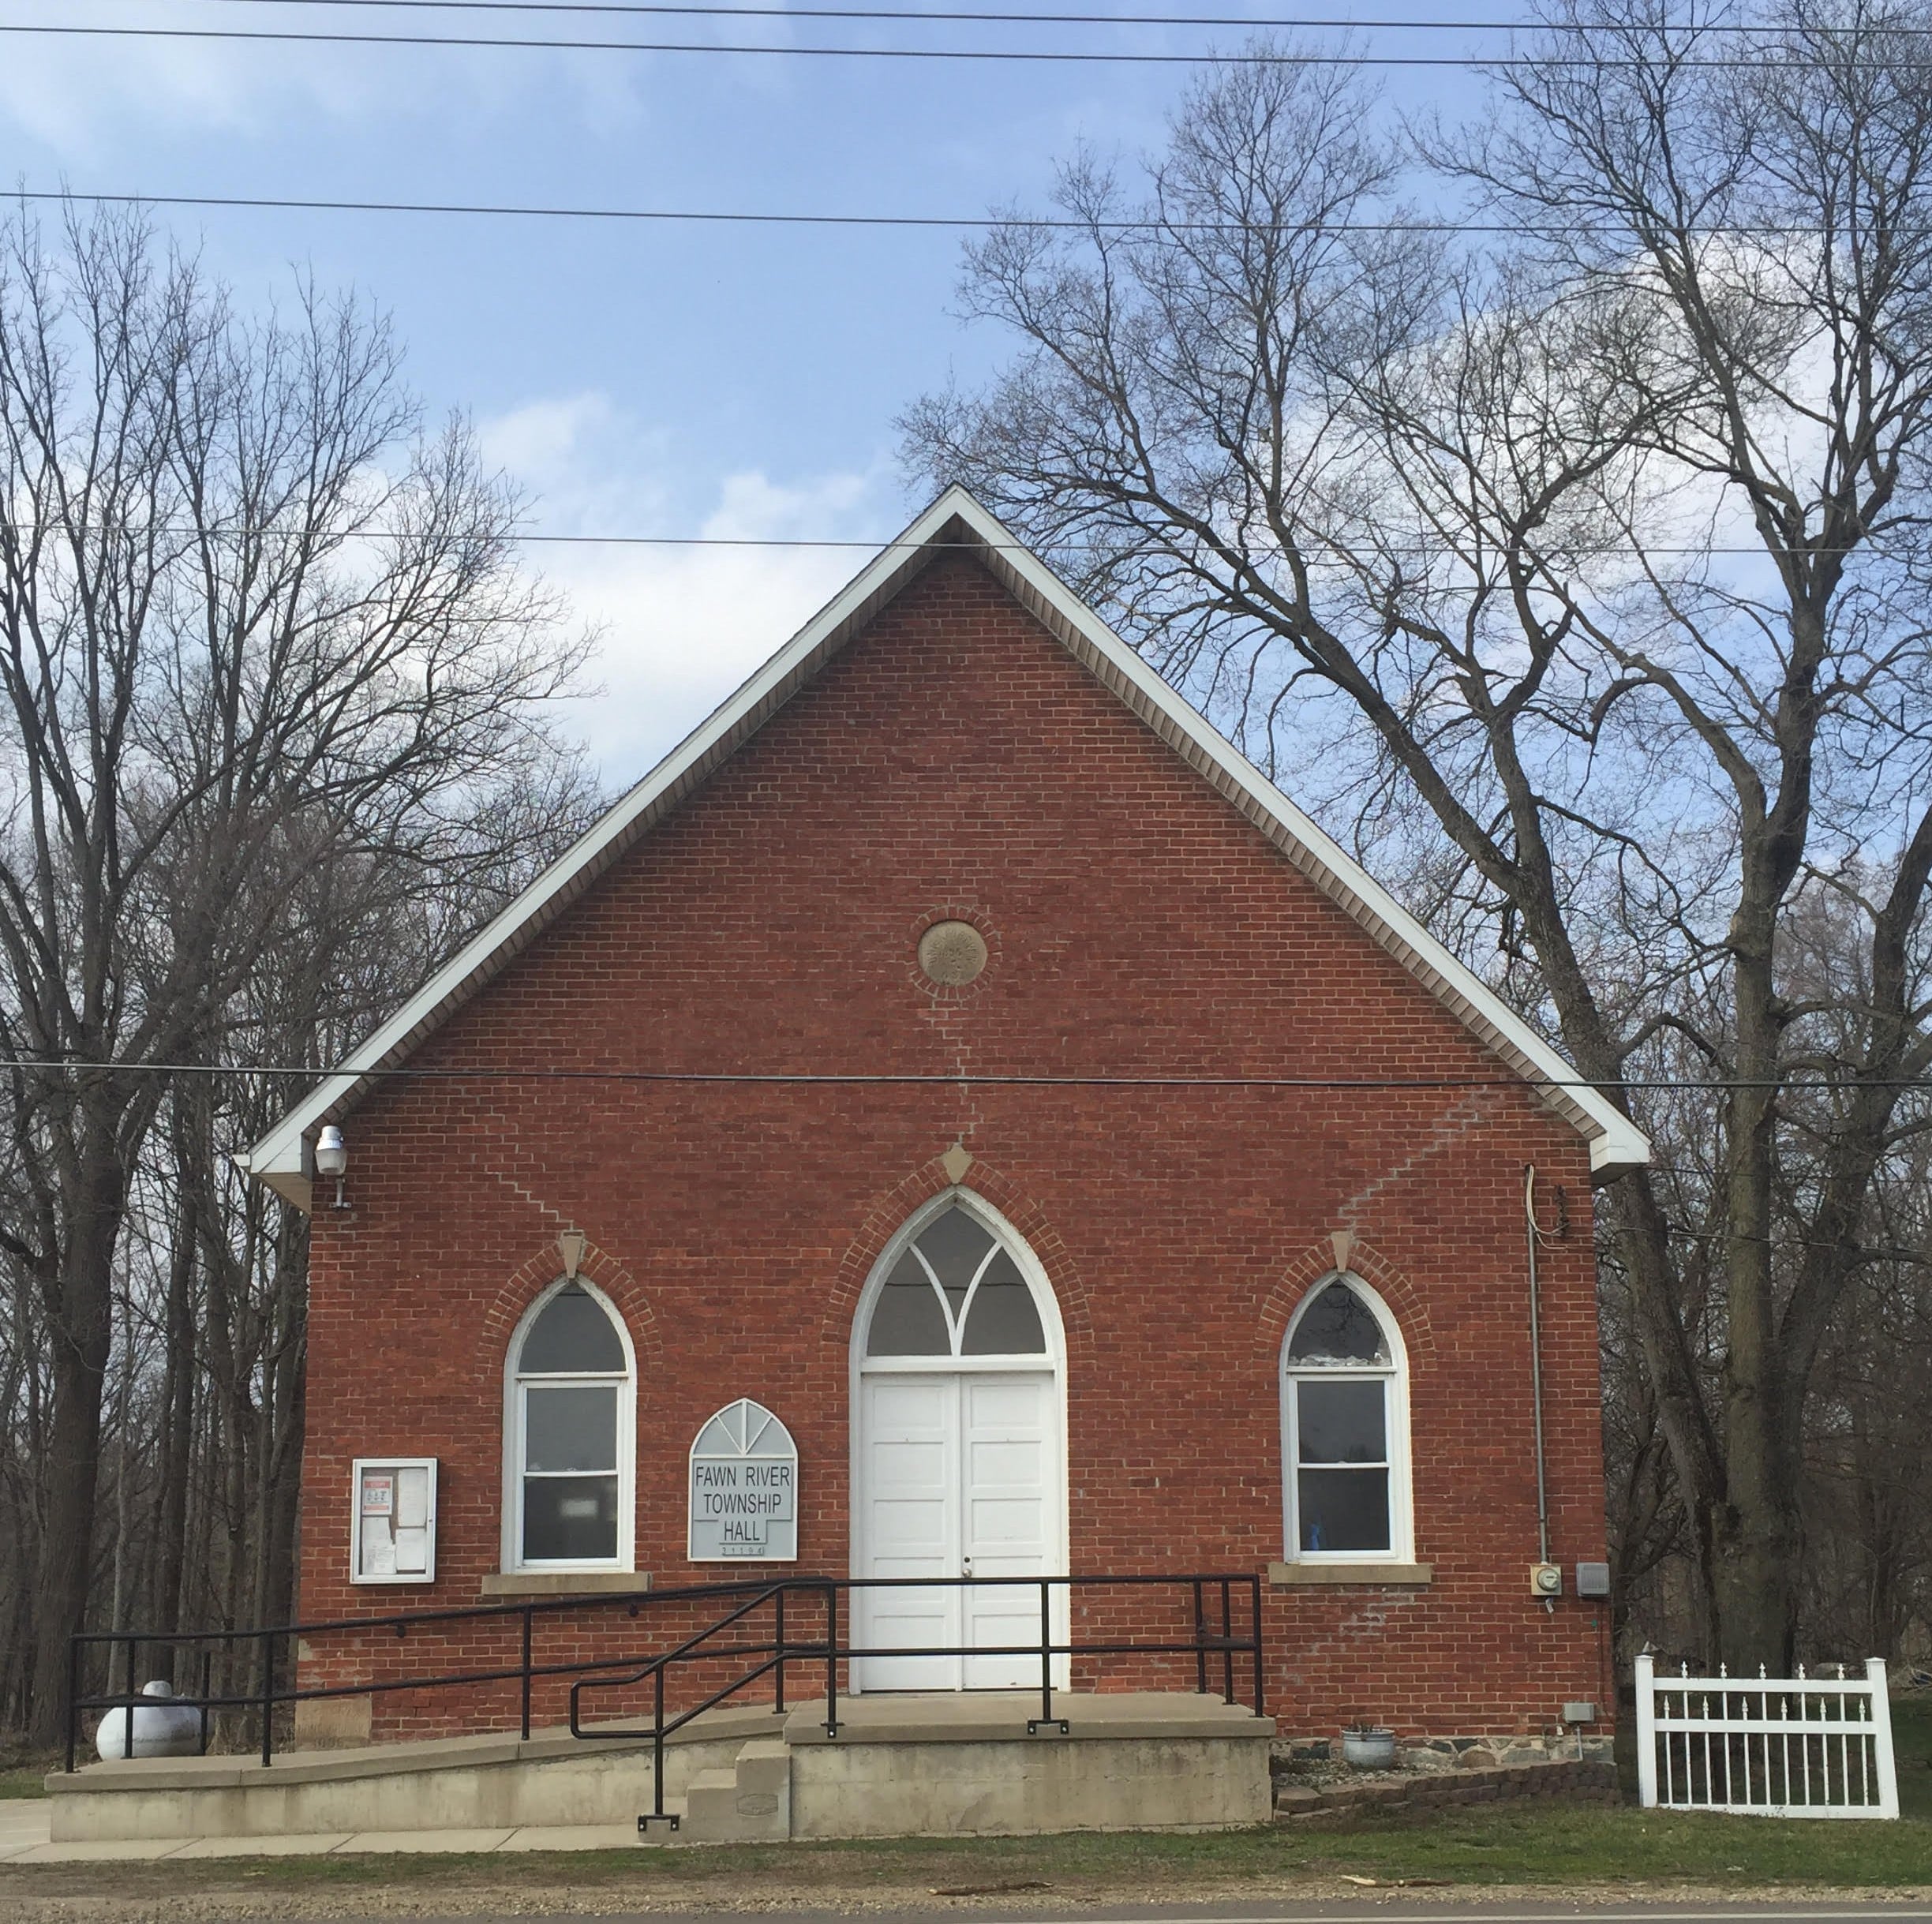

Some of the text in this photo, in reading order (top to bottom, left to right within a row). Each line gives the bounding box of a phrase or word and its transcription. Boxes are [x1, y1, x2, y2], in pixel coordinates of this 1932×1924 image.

[696, 1466, 790, 1487] FAWN RIVER
[703, 1493, 781, 1514] TOWNSHIP
[724, 1520, 760, 1541] HALL
